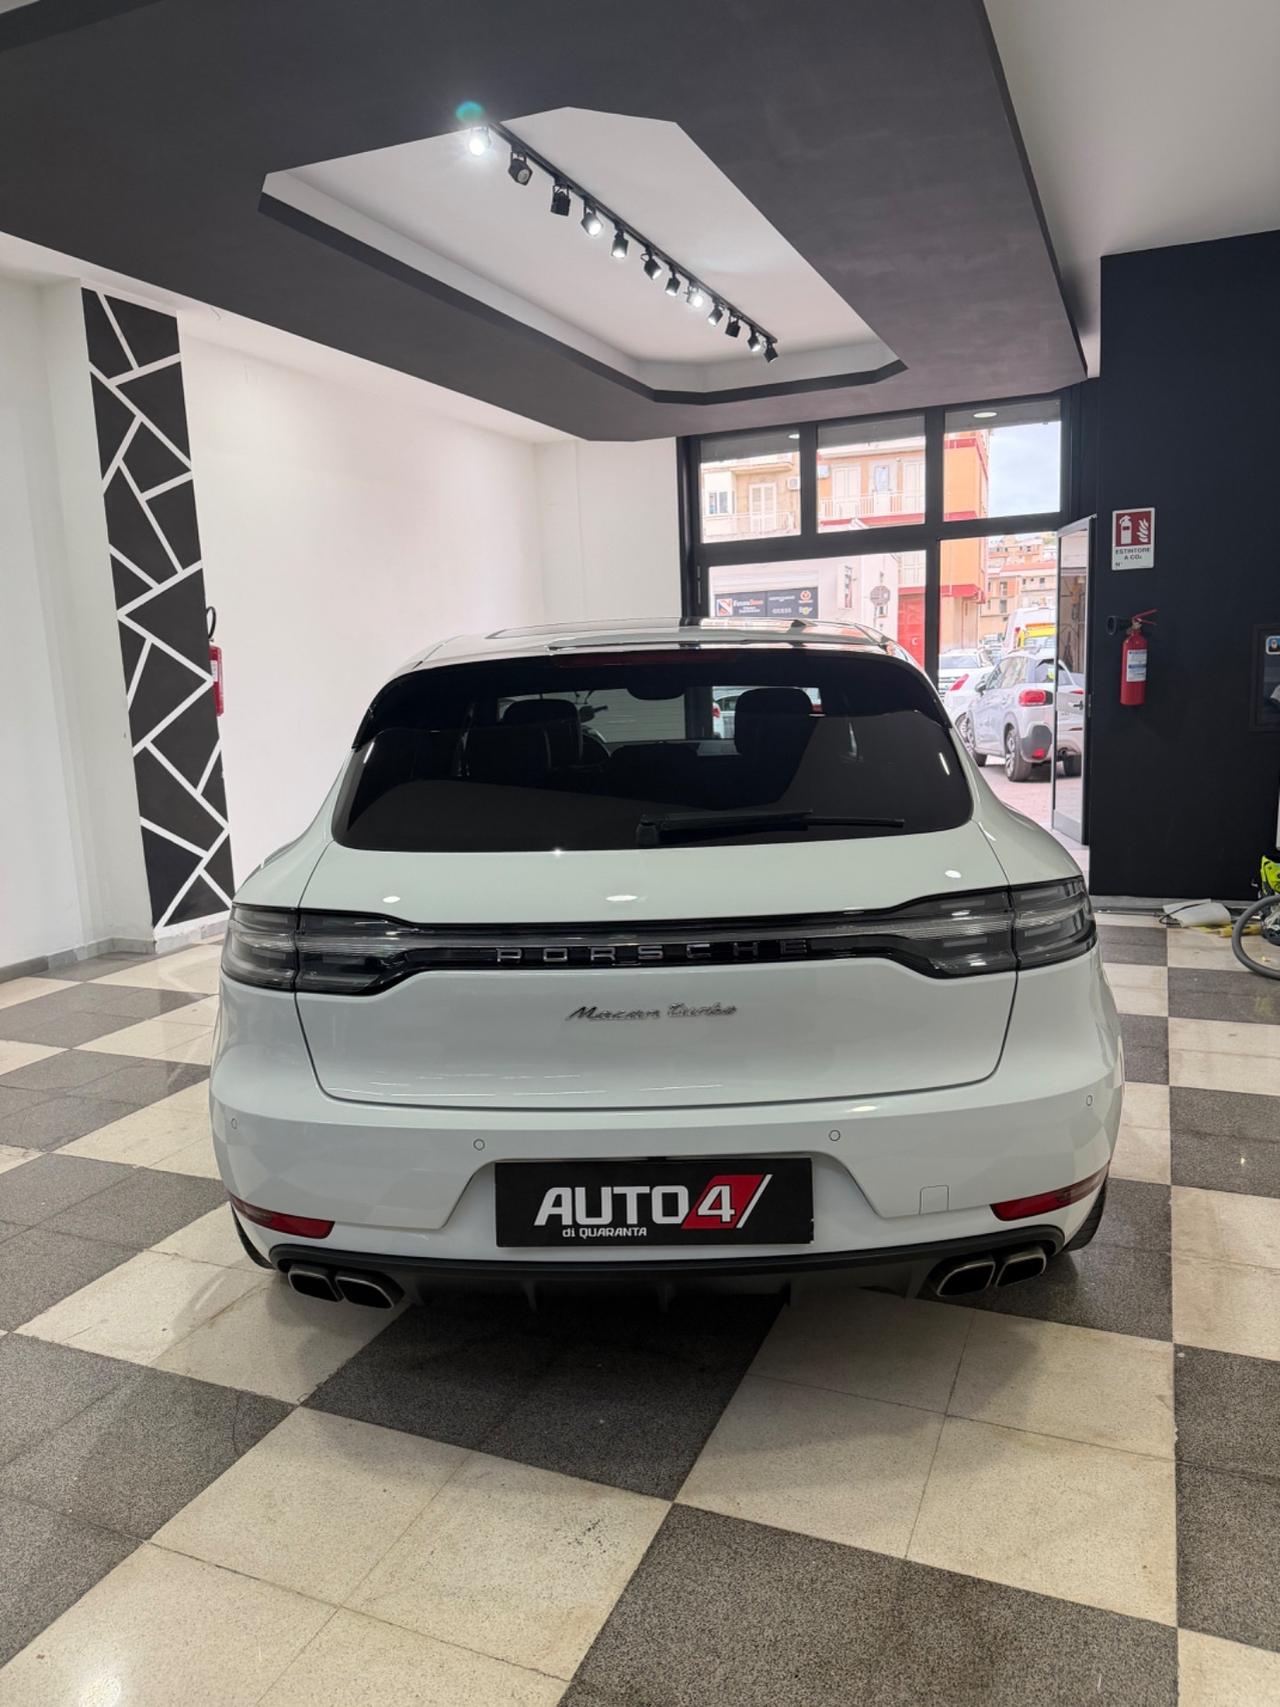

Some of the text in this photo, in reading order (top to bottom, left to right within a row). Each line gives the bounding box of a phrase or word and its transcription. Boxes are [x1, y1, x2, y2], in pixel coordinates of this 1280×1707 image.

[496, 941, 807, 963] PORSCHE
[565, 1002, 738, 1021] Macan turbo
[562, 1227, 647, 1240] di QUARANTA
